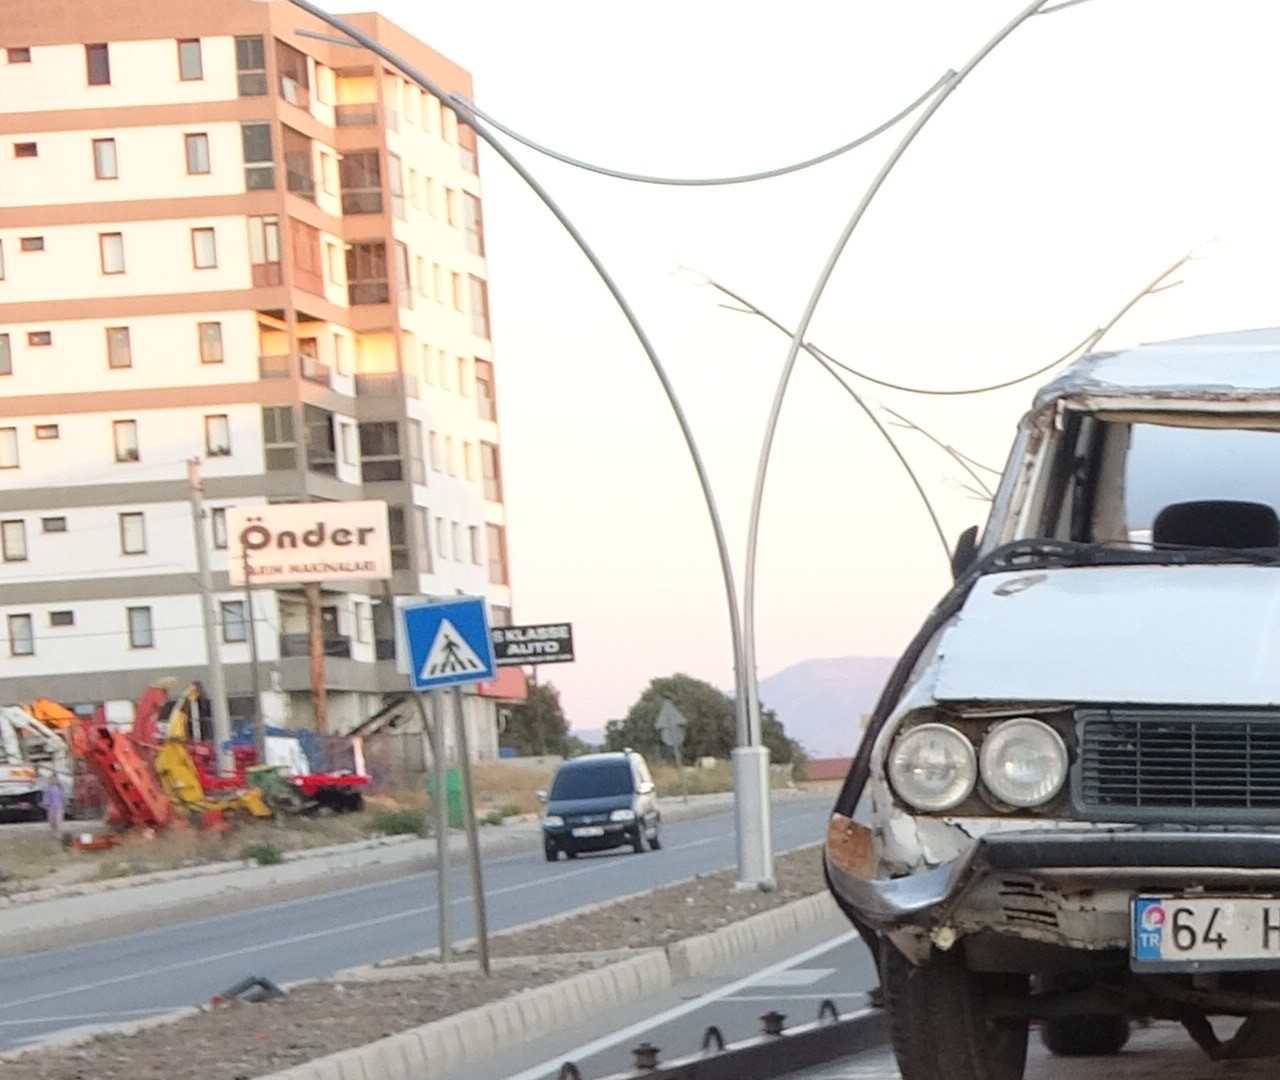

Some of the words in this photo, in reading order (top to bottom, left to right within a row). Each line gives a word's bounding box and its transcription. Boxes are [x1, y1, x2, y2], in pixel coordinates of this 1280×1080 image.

[240, 515, 375, 550] Önder
[504, 625, 570, 642] KLASSE
[506, 640, 560, 656] AUTO
[1171, 907, 1227, 951] 64
[1139, 933, 1160, 947] TR
